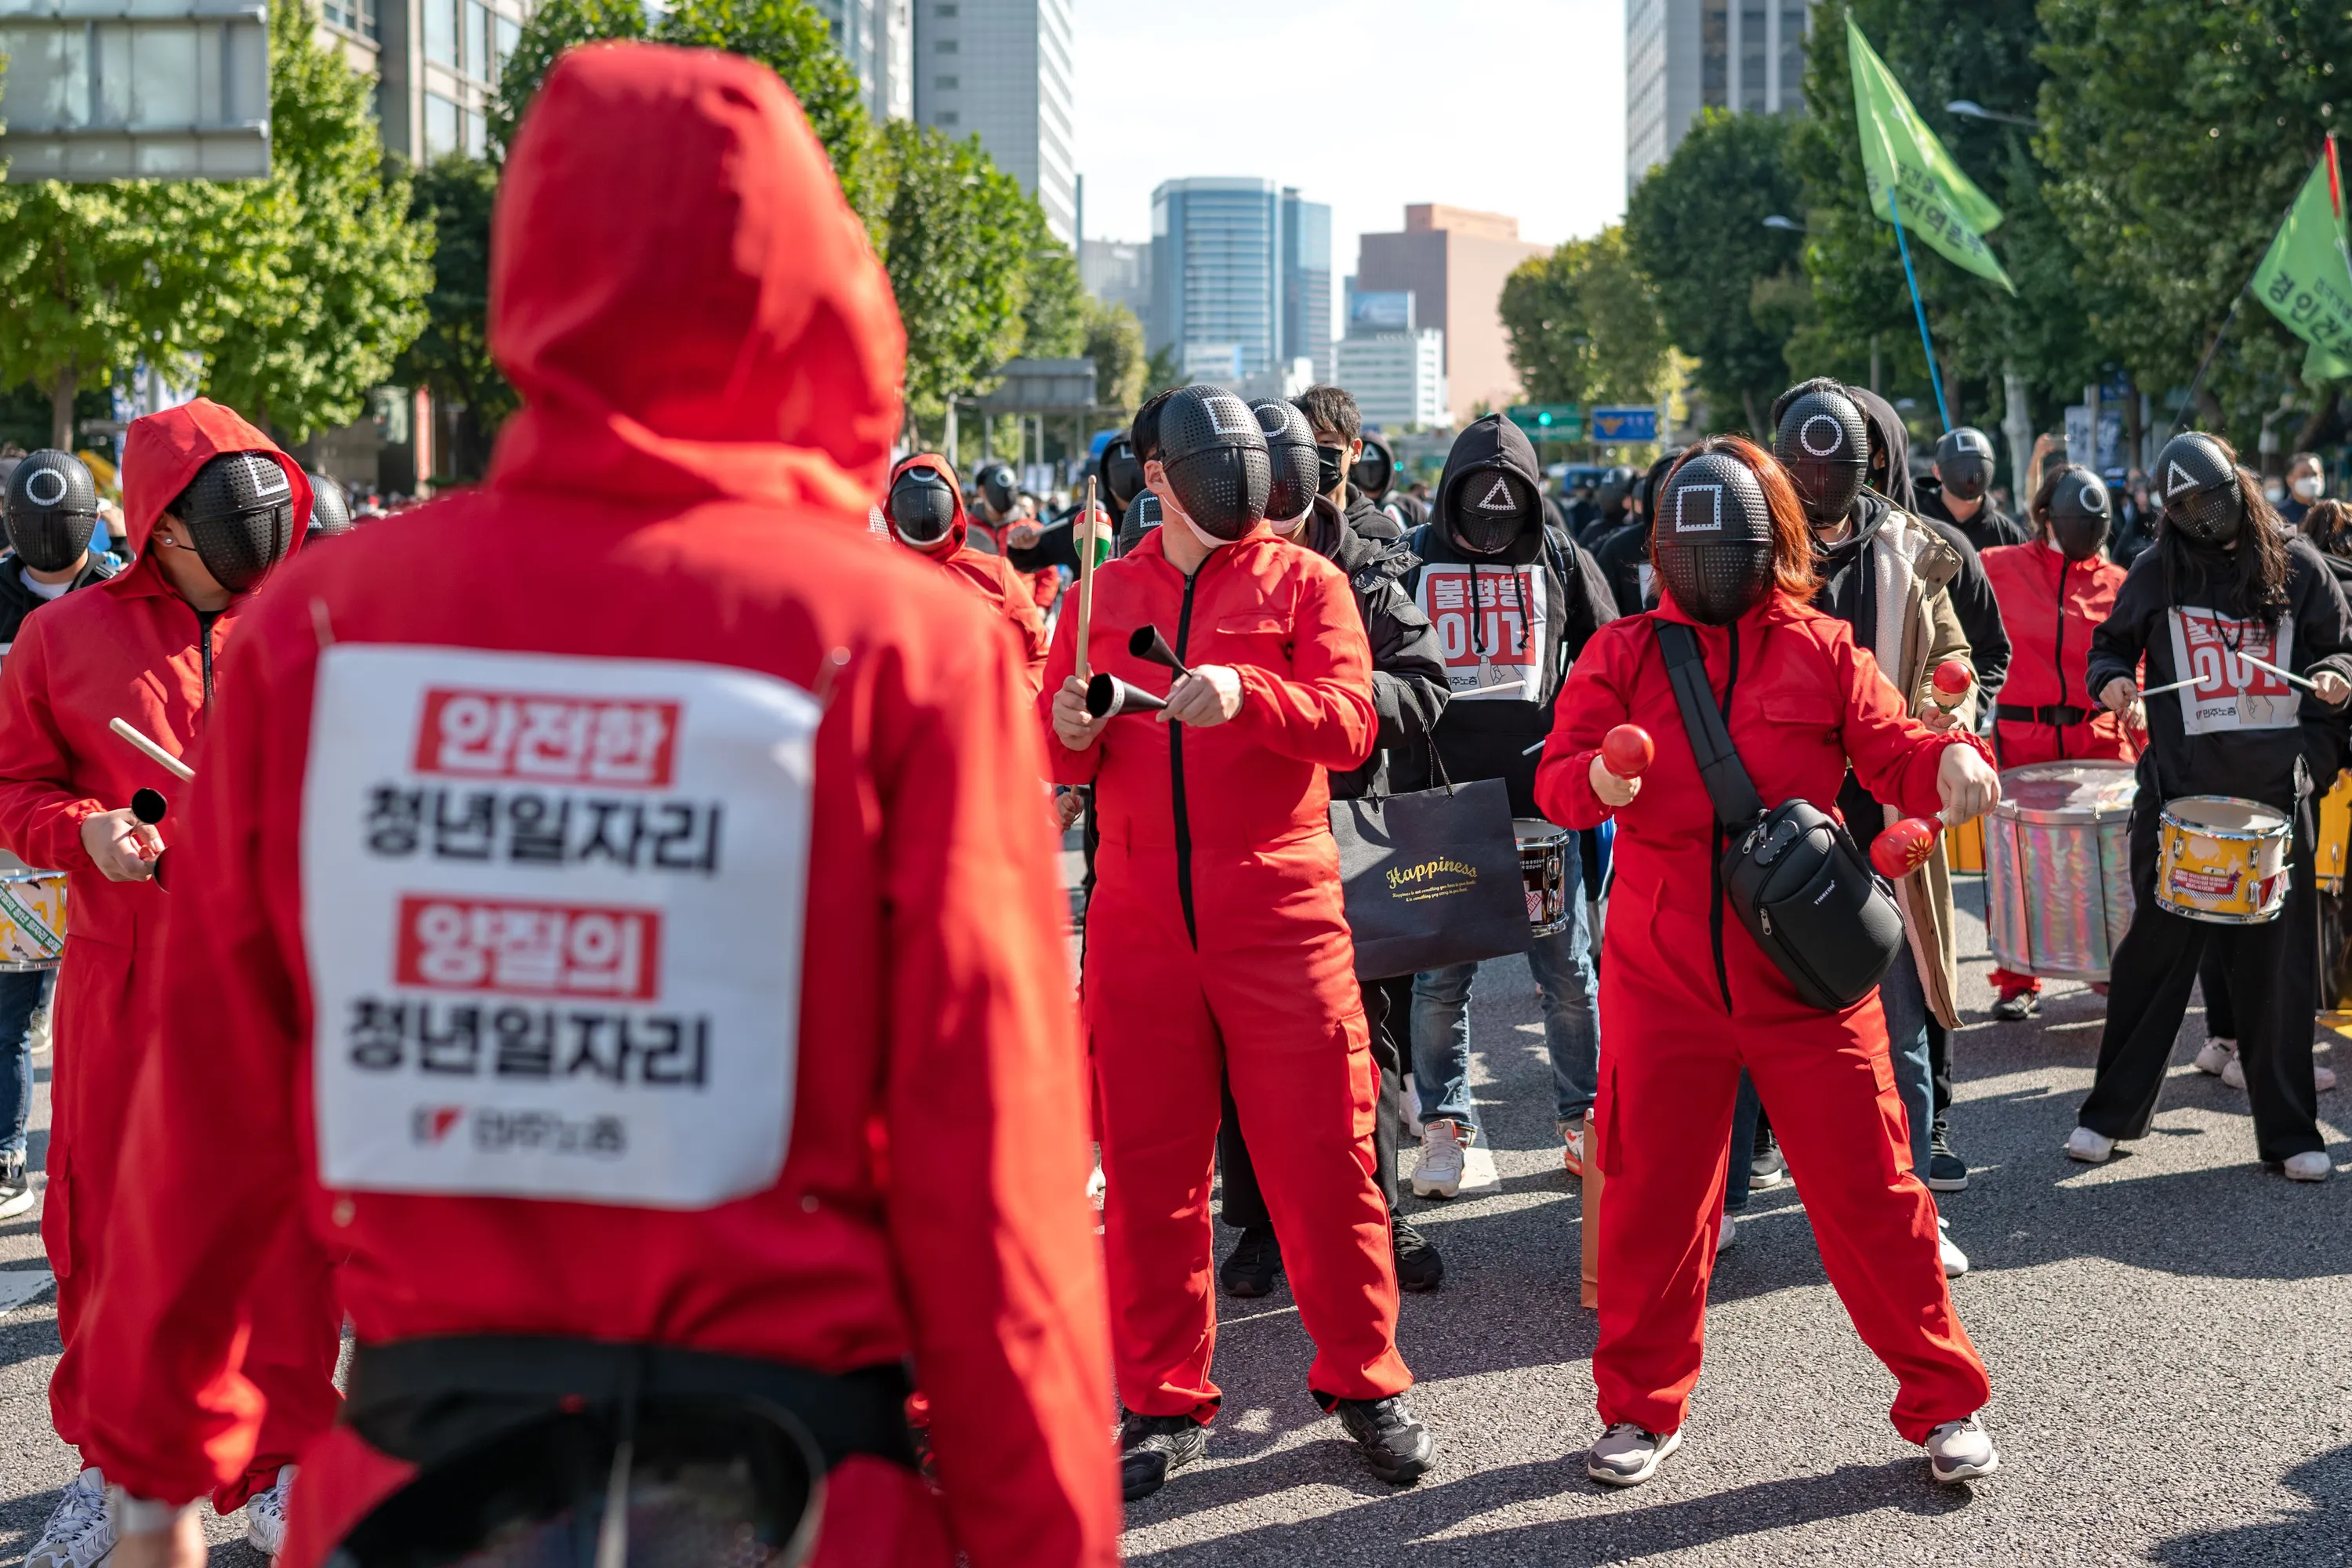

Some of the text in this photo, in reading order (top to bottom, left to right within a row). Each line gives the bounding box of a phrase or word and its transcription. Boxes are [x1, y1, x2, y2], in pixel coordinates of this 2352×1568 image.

[1435, 579, 1526, 609] 불평등
[1437, 612, 1527, 659] OUT
[438, 695, 669, 783] 안전한
[2203, 707, 2236, 719] 민주노총
[365, 780, 724, 876] 청년일자리
[1386, 856, 1478, 889] Happiness
[415, 902, 643, 993] 양질의
[347, 994, 710, 1090] 청년일자리
